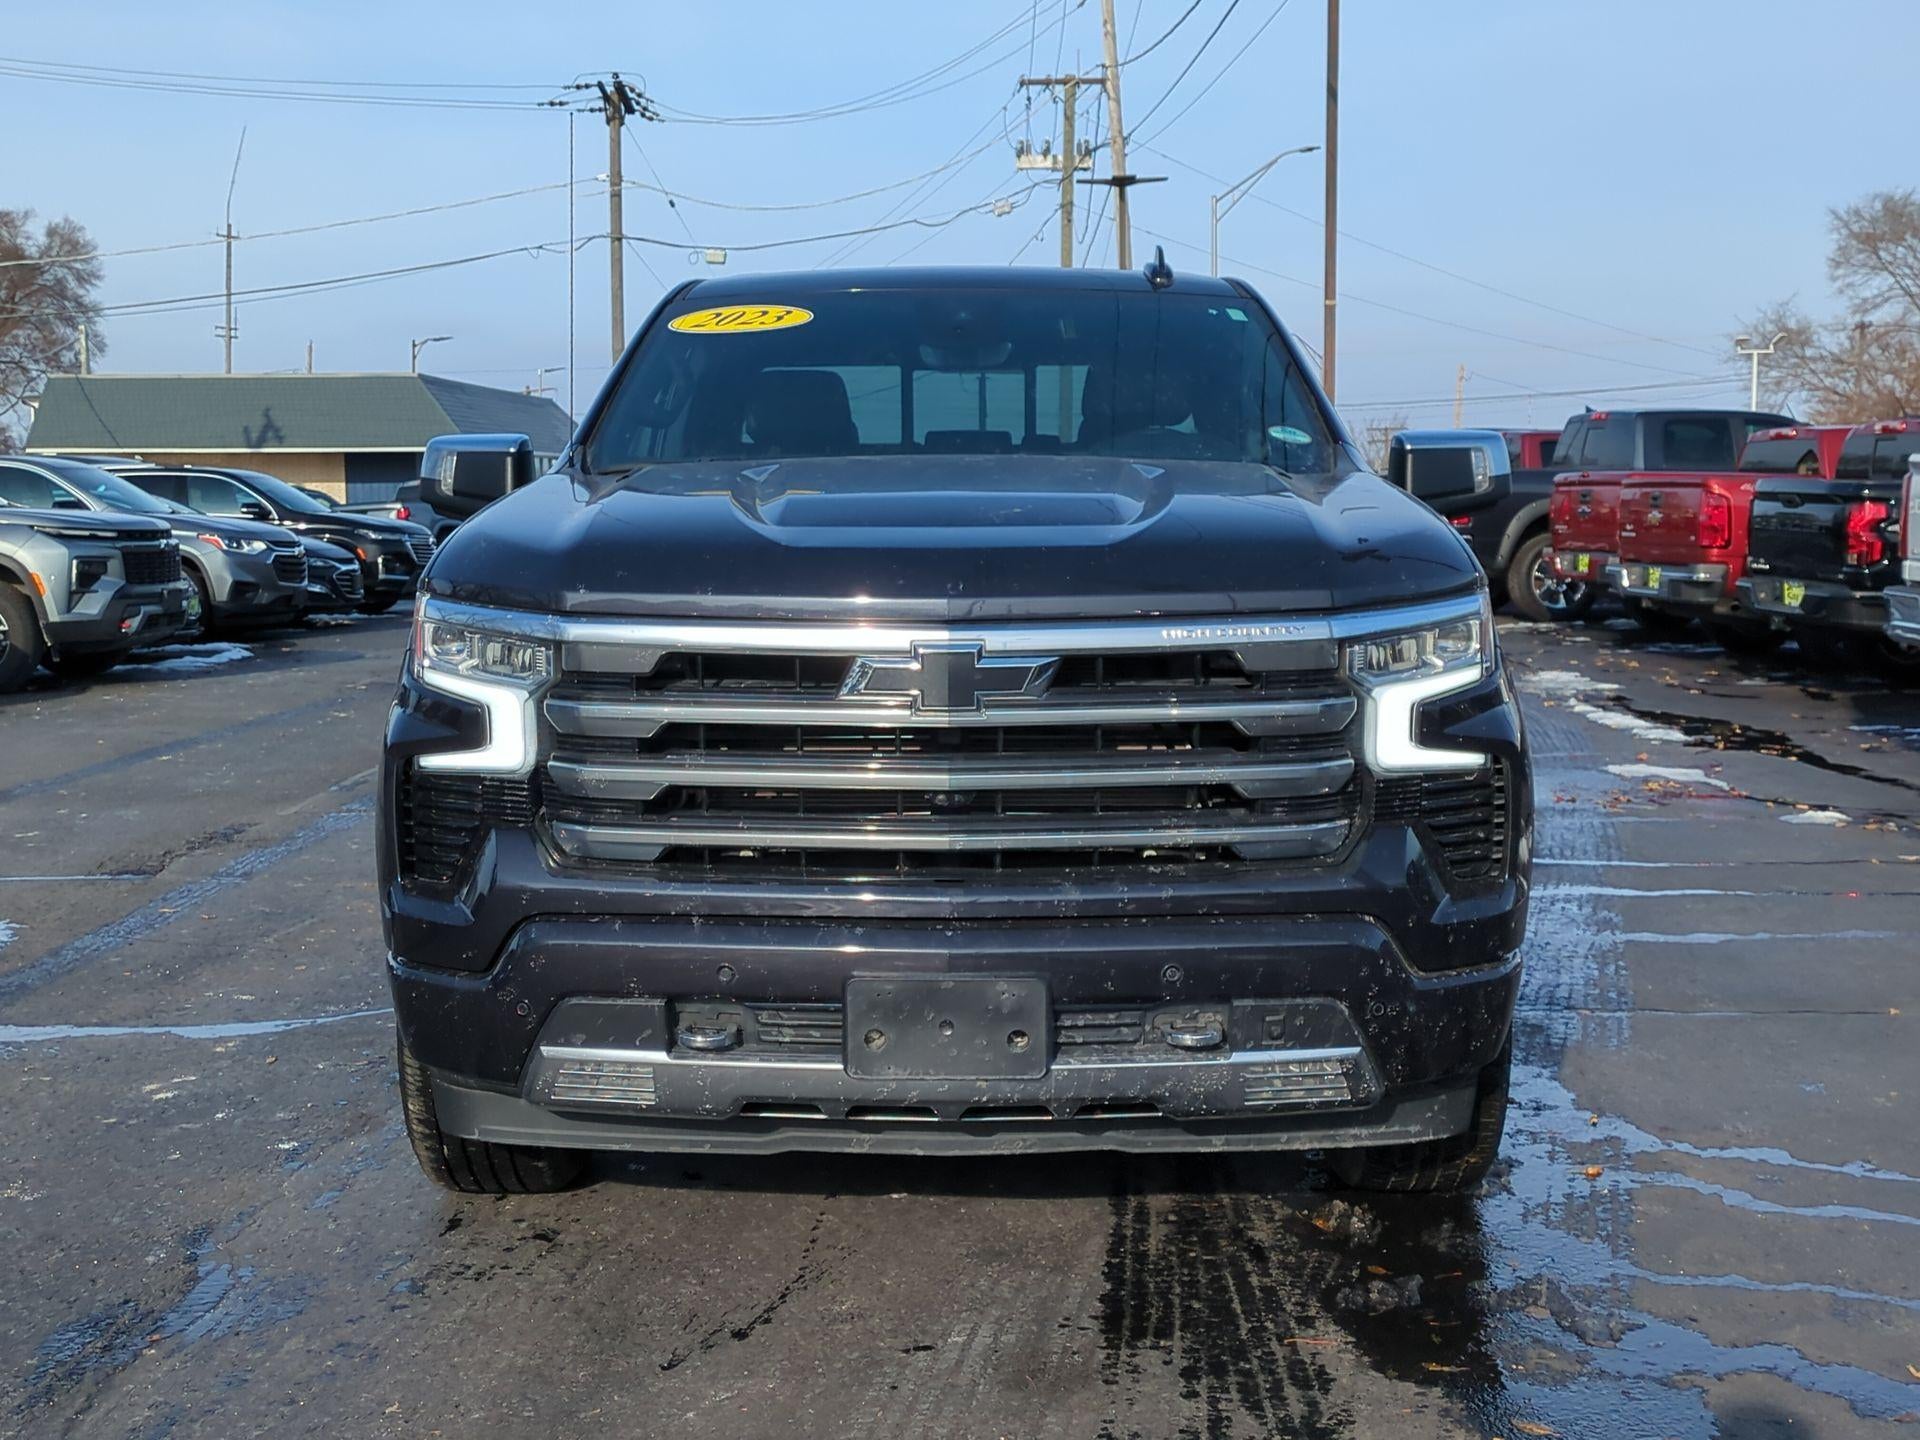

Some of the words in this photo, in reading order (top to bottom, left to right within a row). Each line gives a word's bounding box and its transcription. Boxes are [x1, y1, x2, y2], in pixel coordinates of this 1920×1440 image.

[689, 309, 794, 329] 2023
[1161, 628, 1210, 640] HIGH
[1216, 625, 1306, 638] COUNTRY
